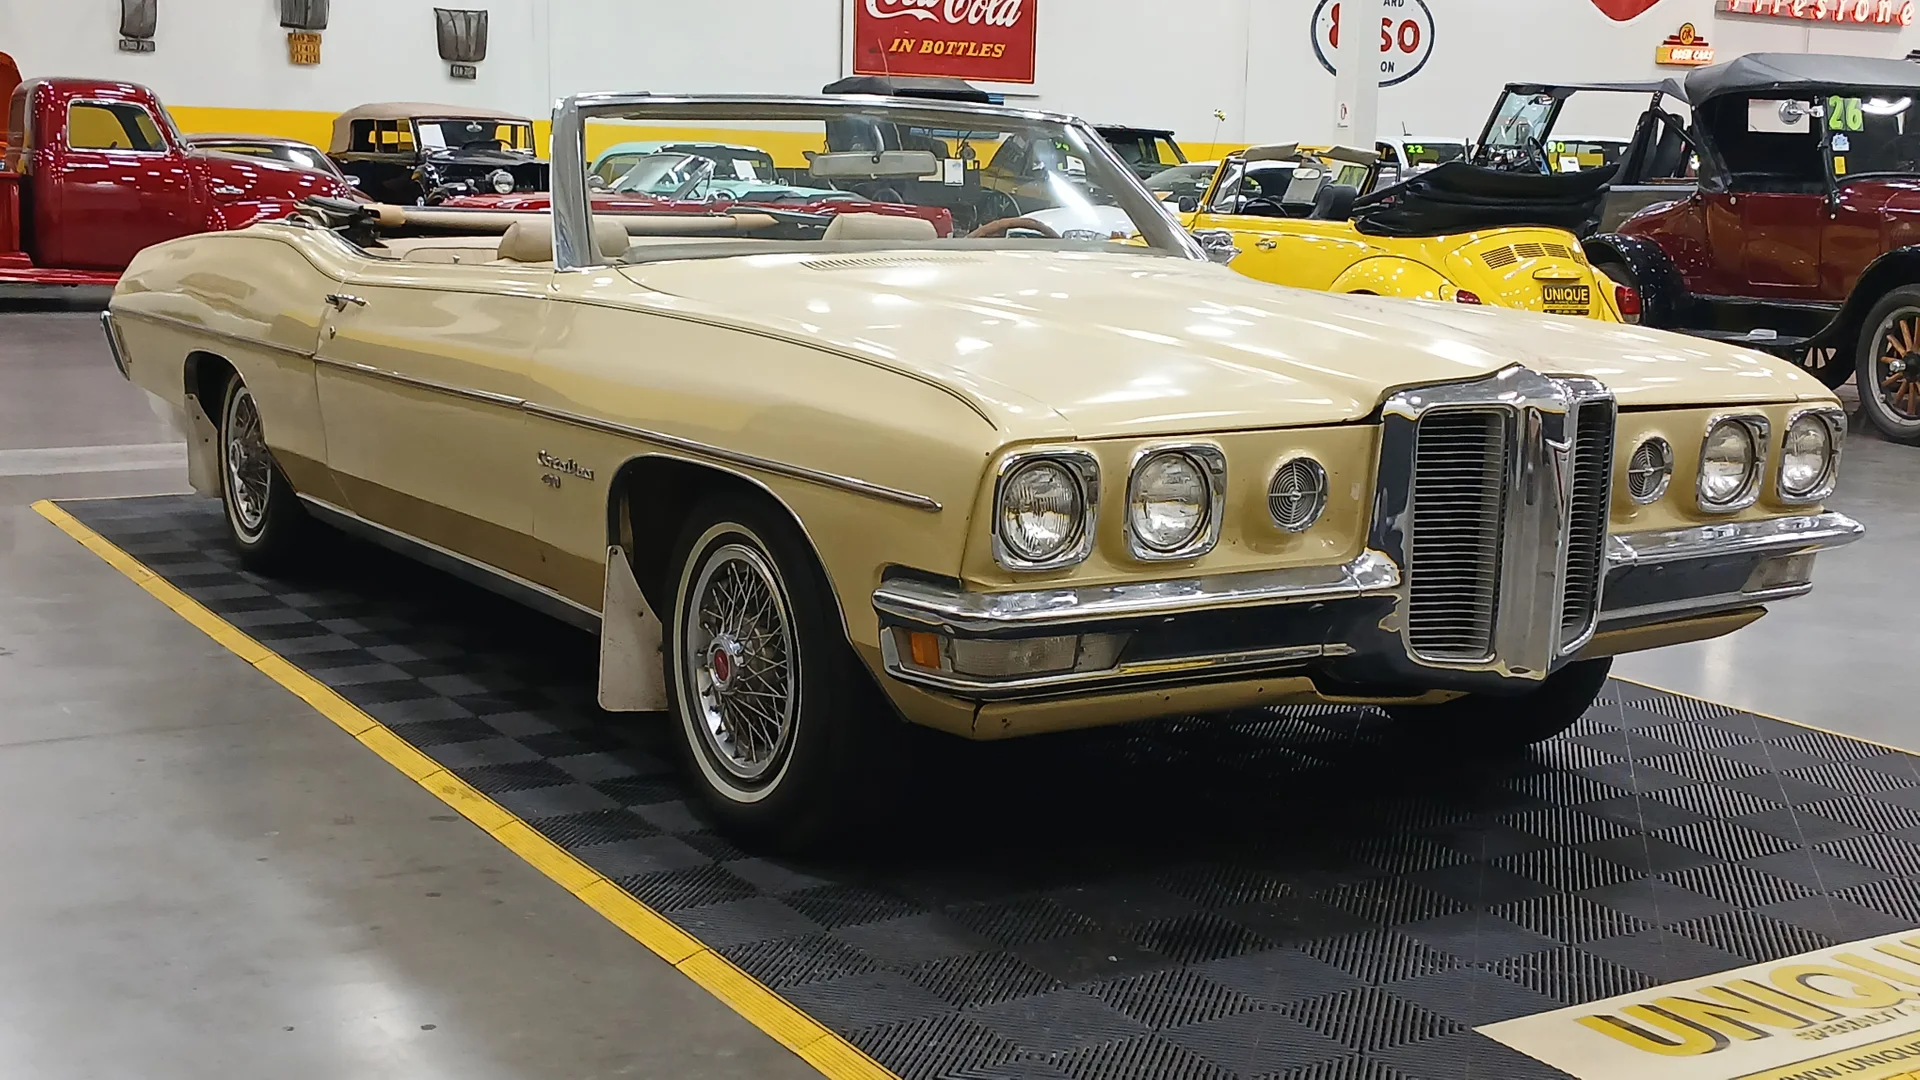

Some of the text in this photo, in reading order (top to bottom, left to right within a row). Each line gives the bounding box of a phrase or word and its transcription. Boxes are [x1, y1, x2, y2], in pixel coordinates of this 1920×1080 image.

[889, 38, 1006, 58] IN BOTTLES
[1828, 95, 1863, 130] 26
[1406, 144, 1424, 154] 22
[1544, 288, 1589, 301] UNIQUE
[1574, 936, 1920, 1057] UNIQU
